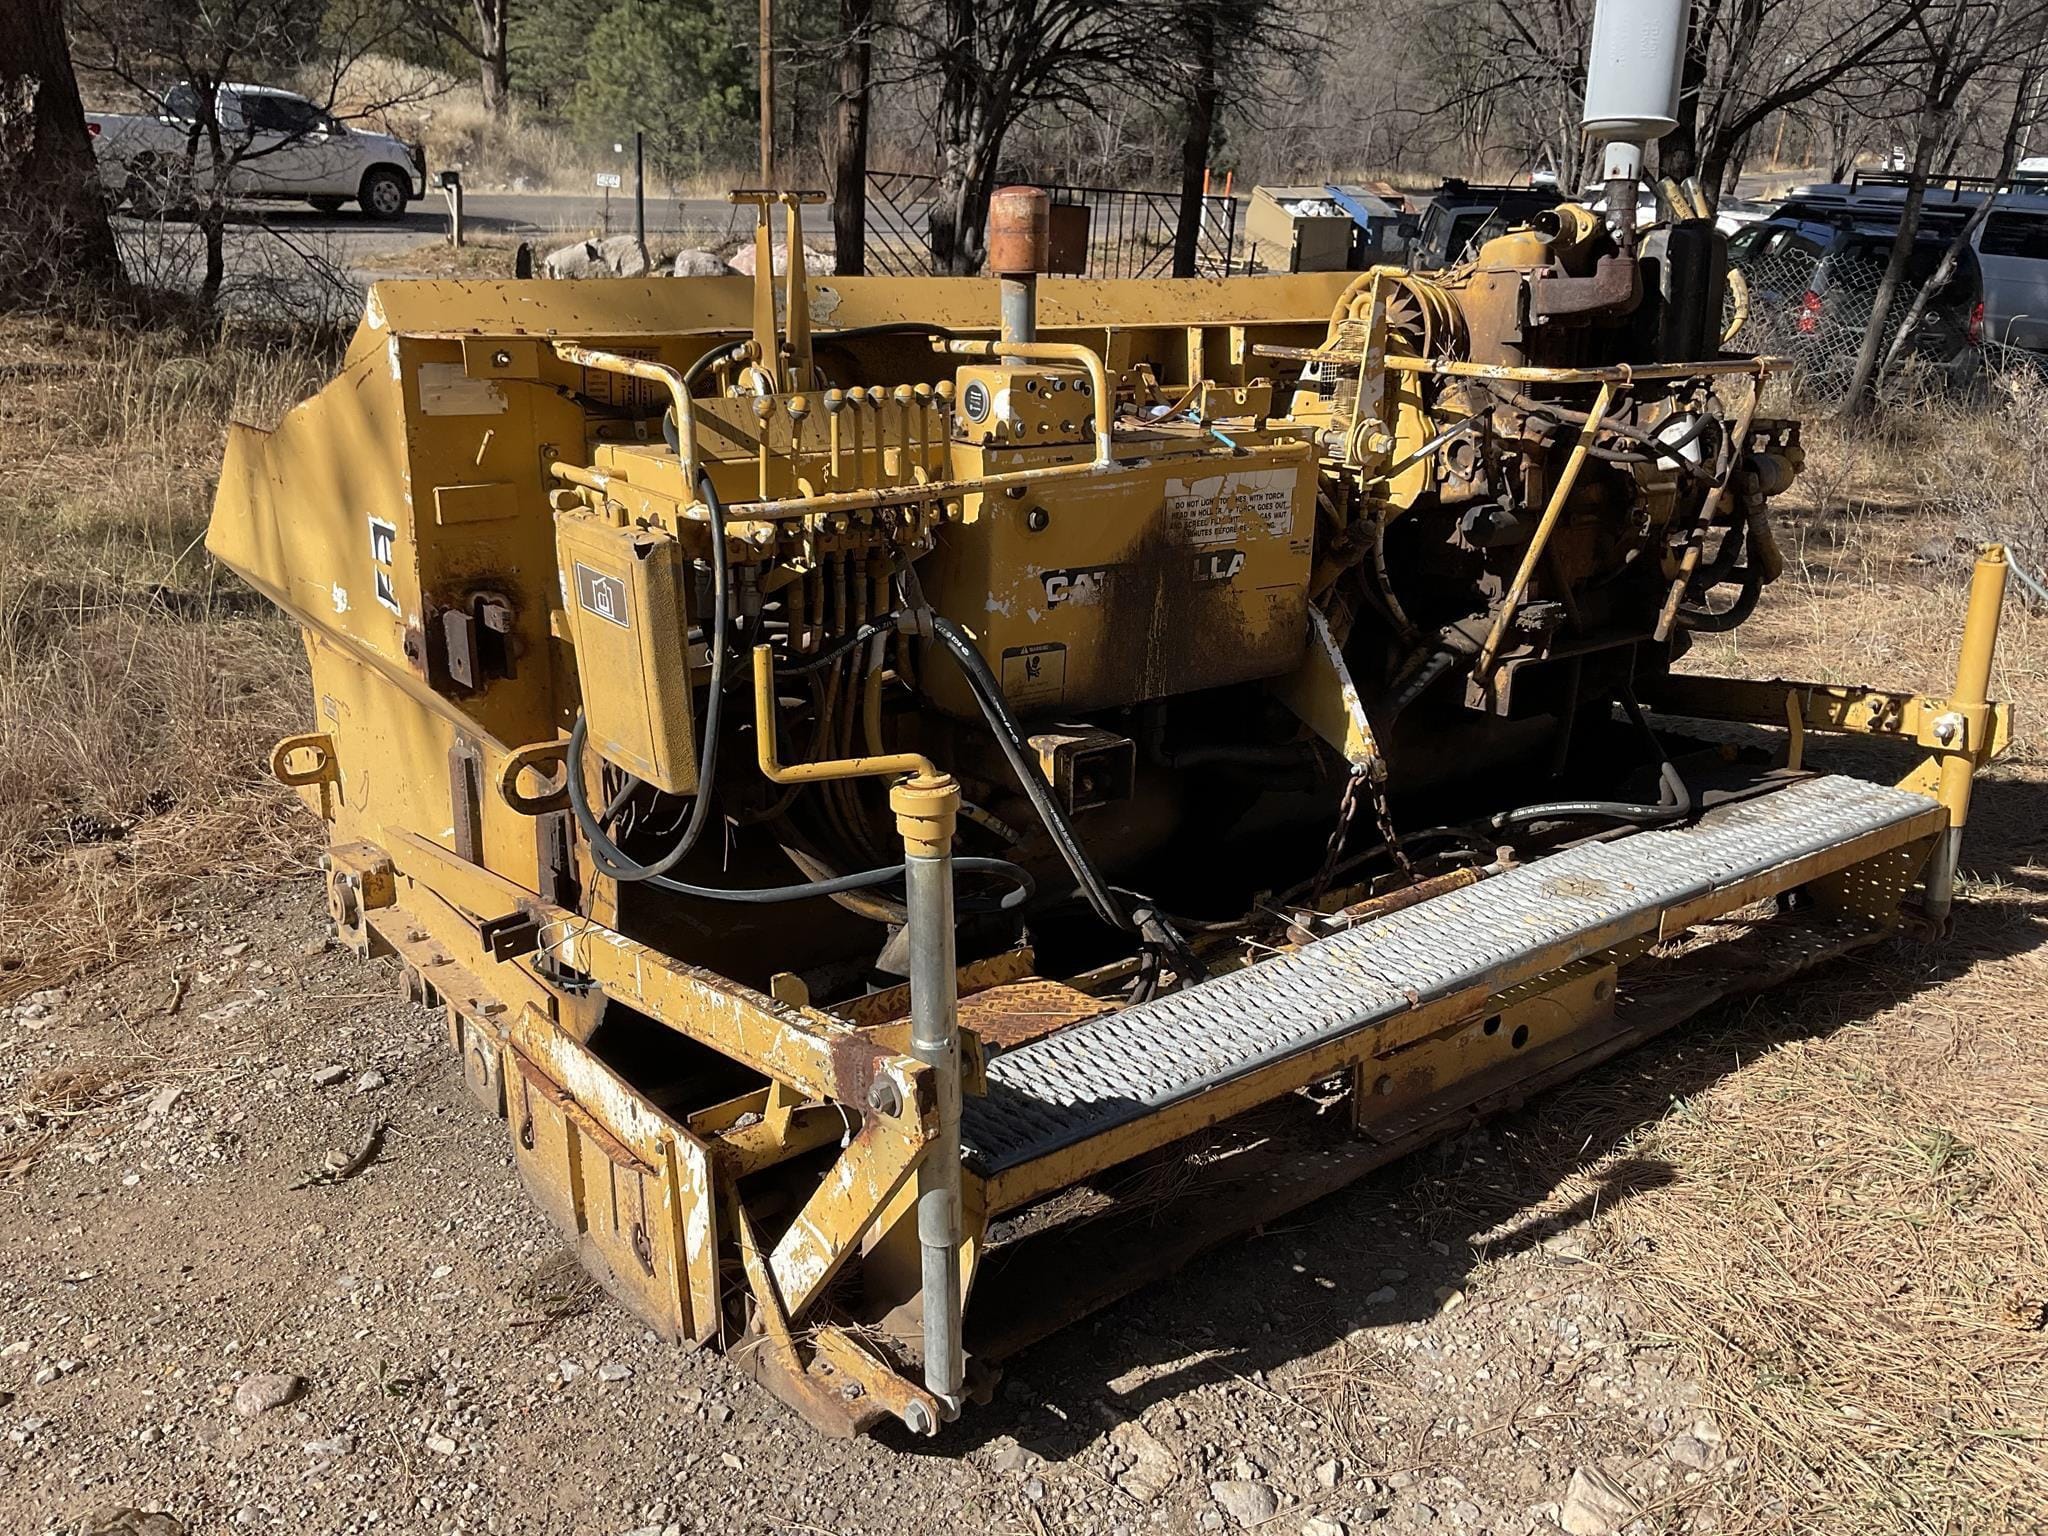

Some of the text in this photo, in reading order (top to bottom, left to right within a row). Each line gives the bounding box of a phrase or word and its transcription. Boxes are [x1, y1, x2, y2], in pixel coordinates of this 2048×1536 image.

[1175, 492, 1285, 509] DO NOT LIGH TOHES WITH TORCH
[1171, 511, 1188, 519] HEAD
[1257, 502, 1273, 510] GOES
[1274, 511, 1287, 519] WAIT
[1215, 525, 1237, 534] BEFORE
